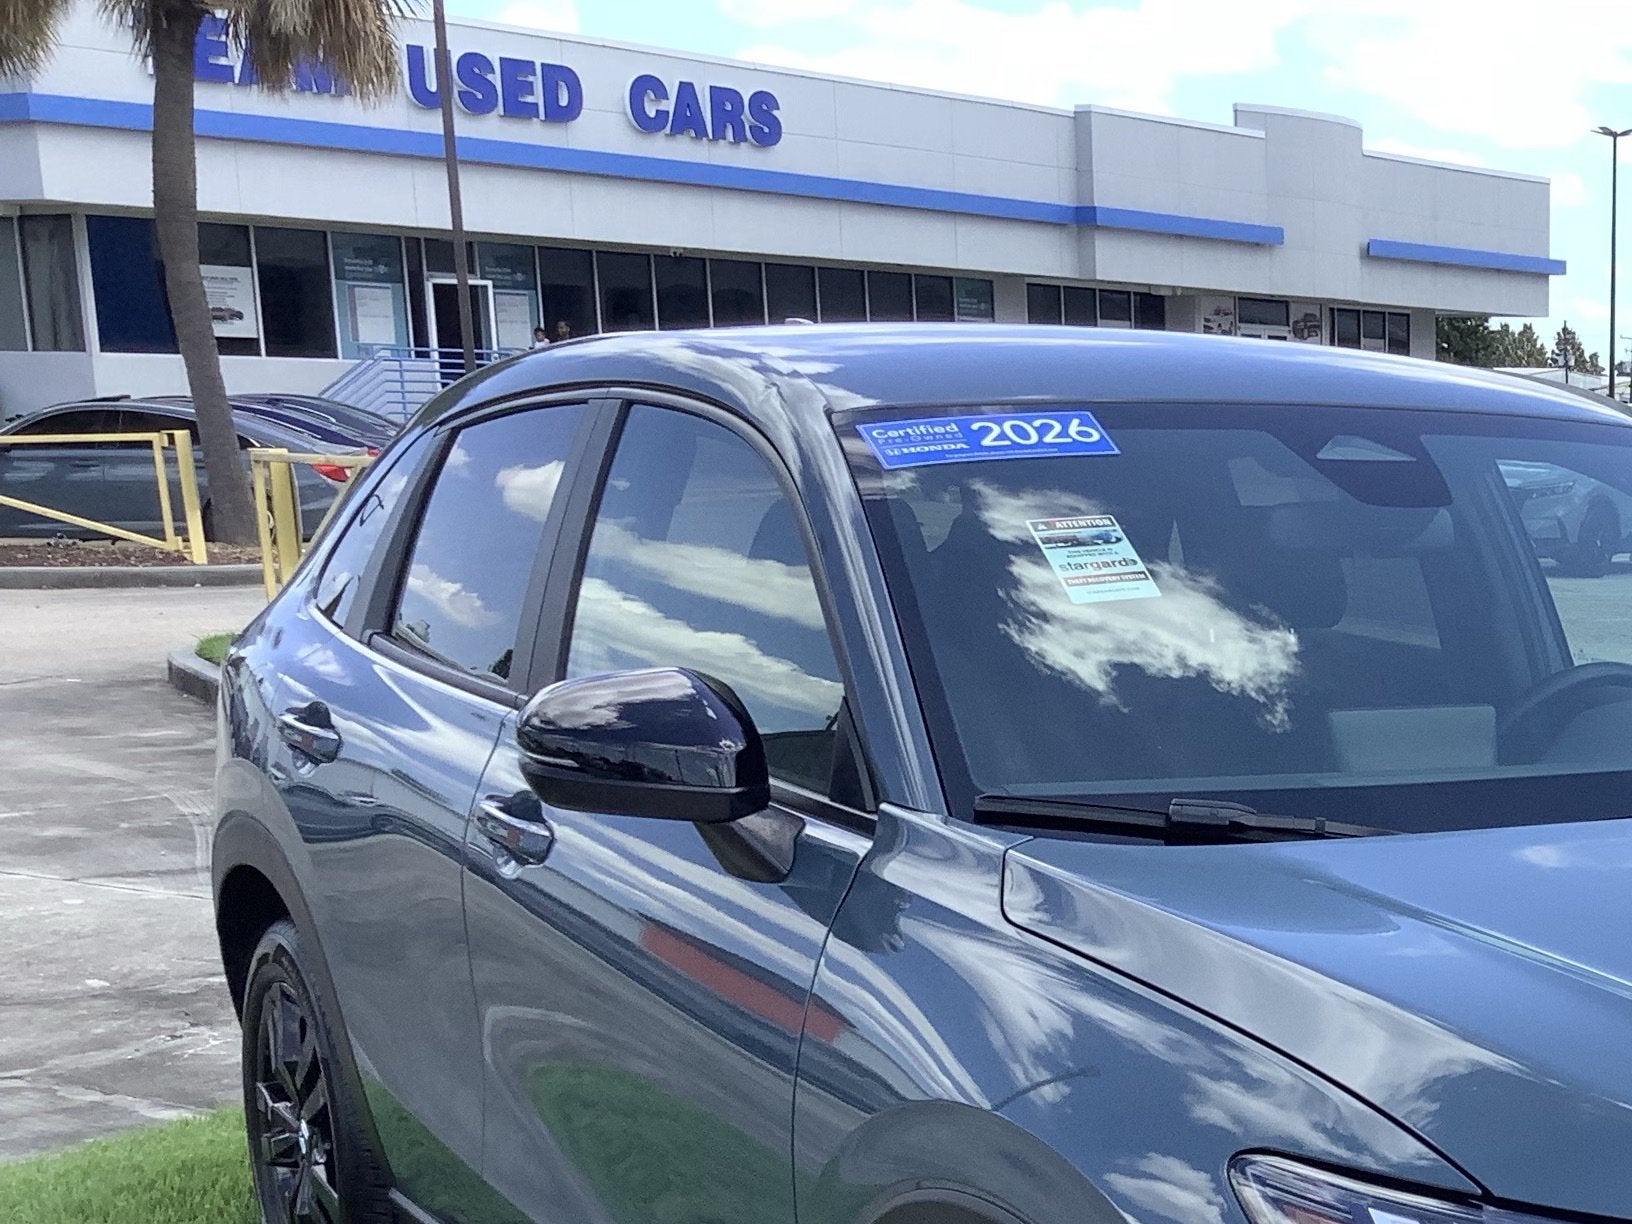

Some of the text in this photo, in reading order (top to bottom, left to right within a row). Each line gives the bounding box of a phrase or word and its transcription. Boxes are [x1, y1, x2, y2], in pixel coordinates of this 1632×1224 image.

[405, 43, 583, 124] USED
[627, 73, 783, 148] CARS
[871, 422, 959, 439] Certified
[970, 418, 1101, 447] 2026
[878, 432, 963, 444] Pre-Owned
[901, 443, 971, 454] HONDA
[1055, 518, 1113, 529] ATTENTION
